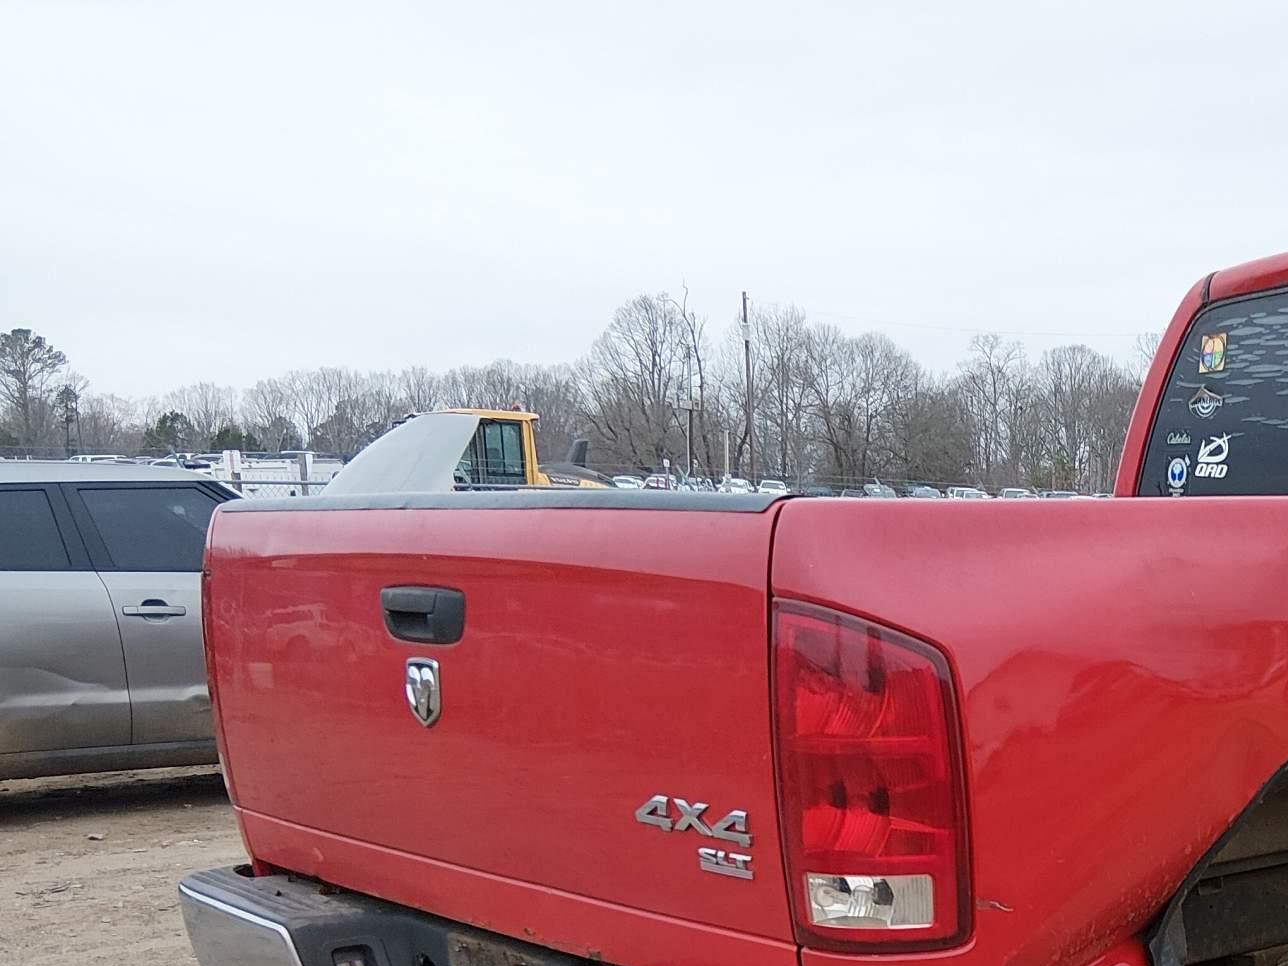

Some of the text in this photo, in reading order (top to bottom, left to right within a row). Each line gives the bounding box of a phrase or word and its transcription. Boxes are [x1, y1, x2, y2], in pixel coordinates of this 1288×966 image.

[1194, 463, 1228, 479] QAD
[635, 795, 753, 848] 4X4
[698, 847, 752, 871] SLT
